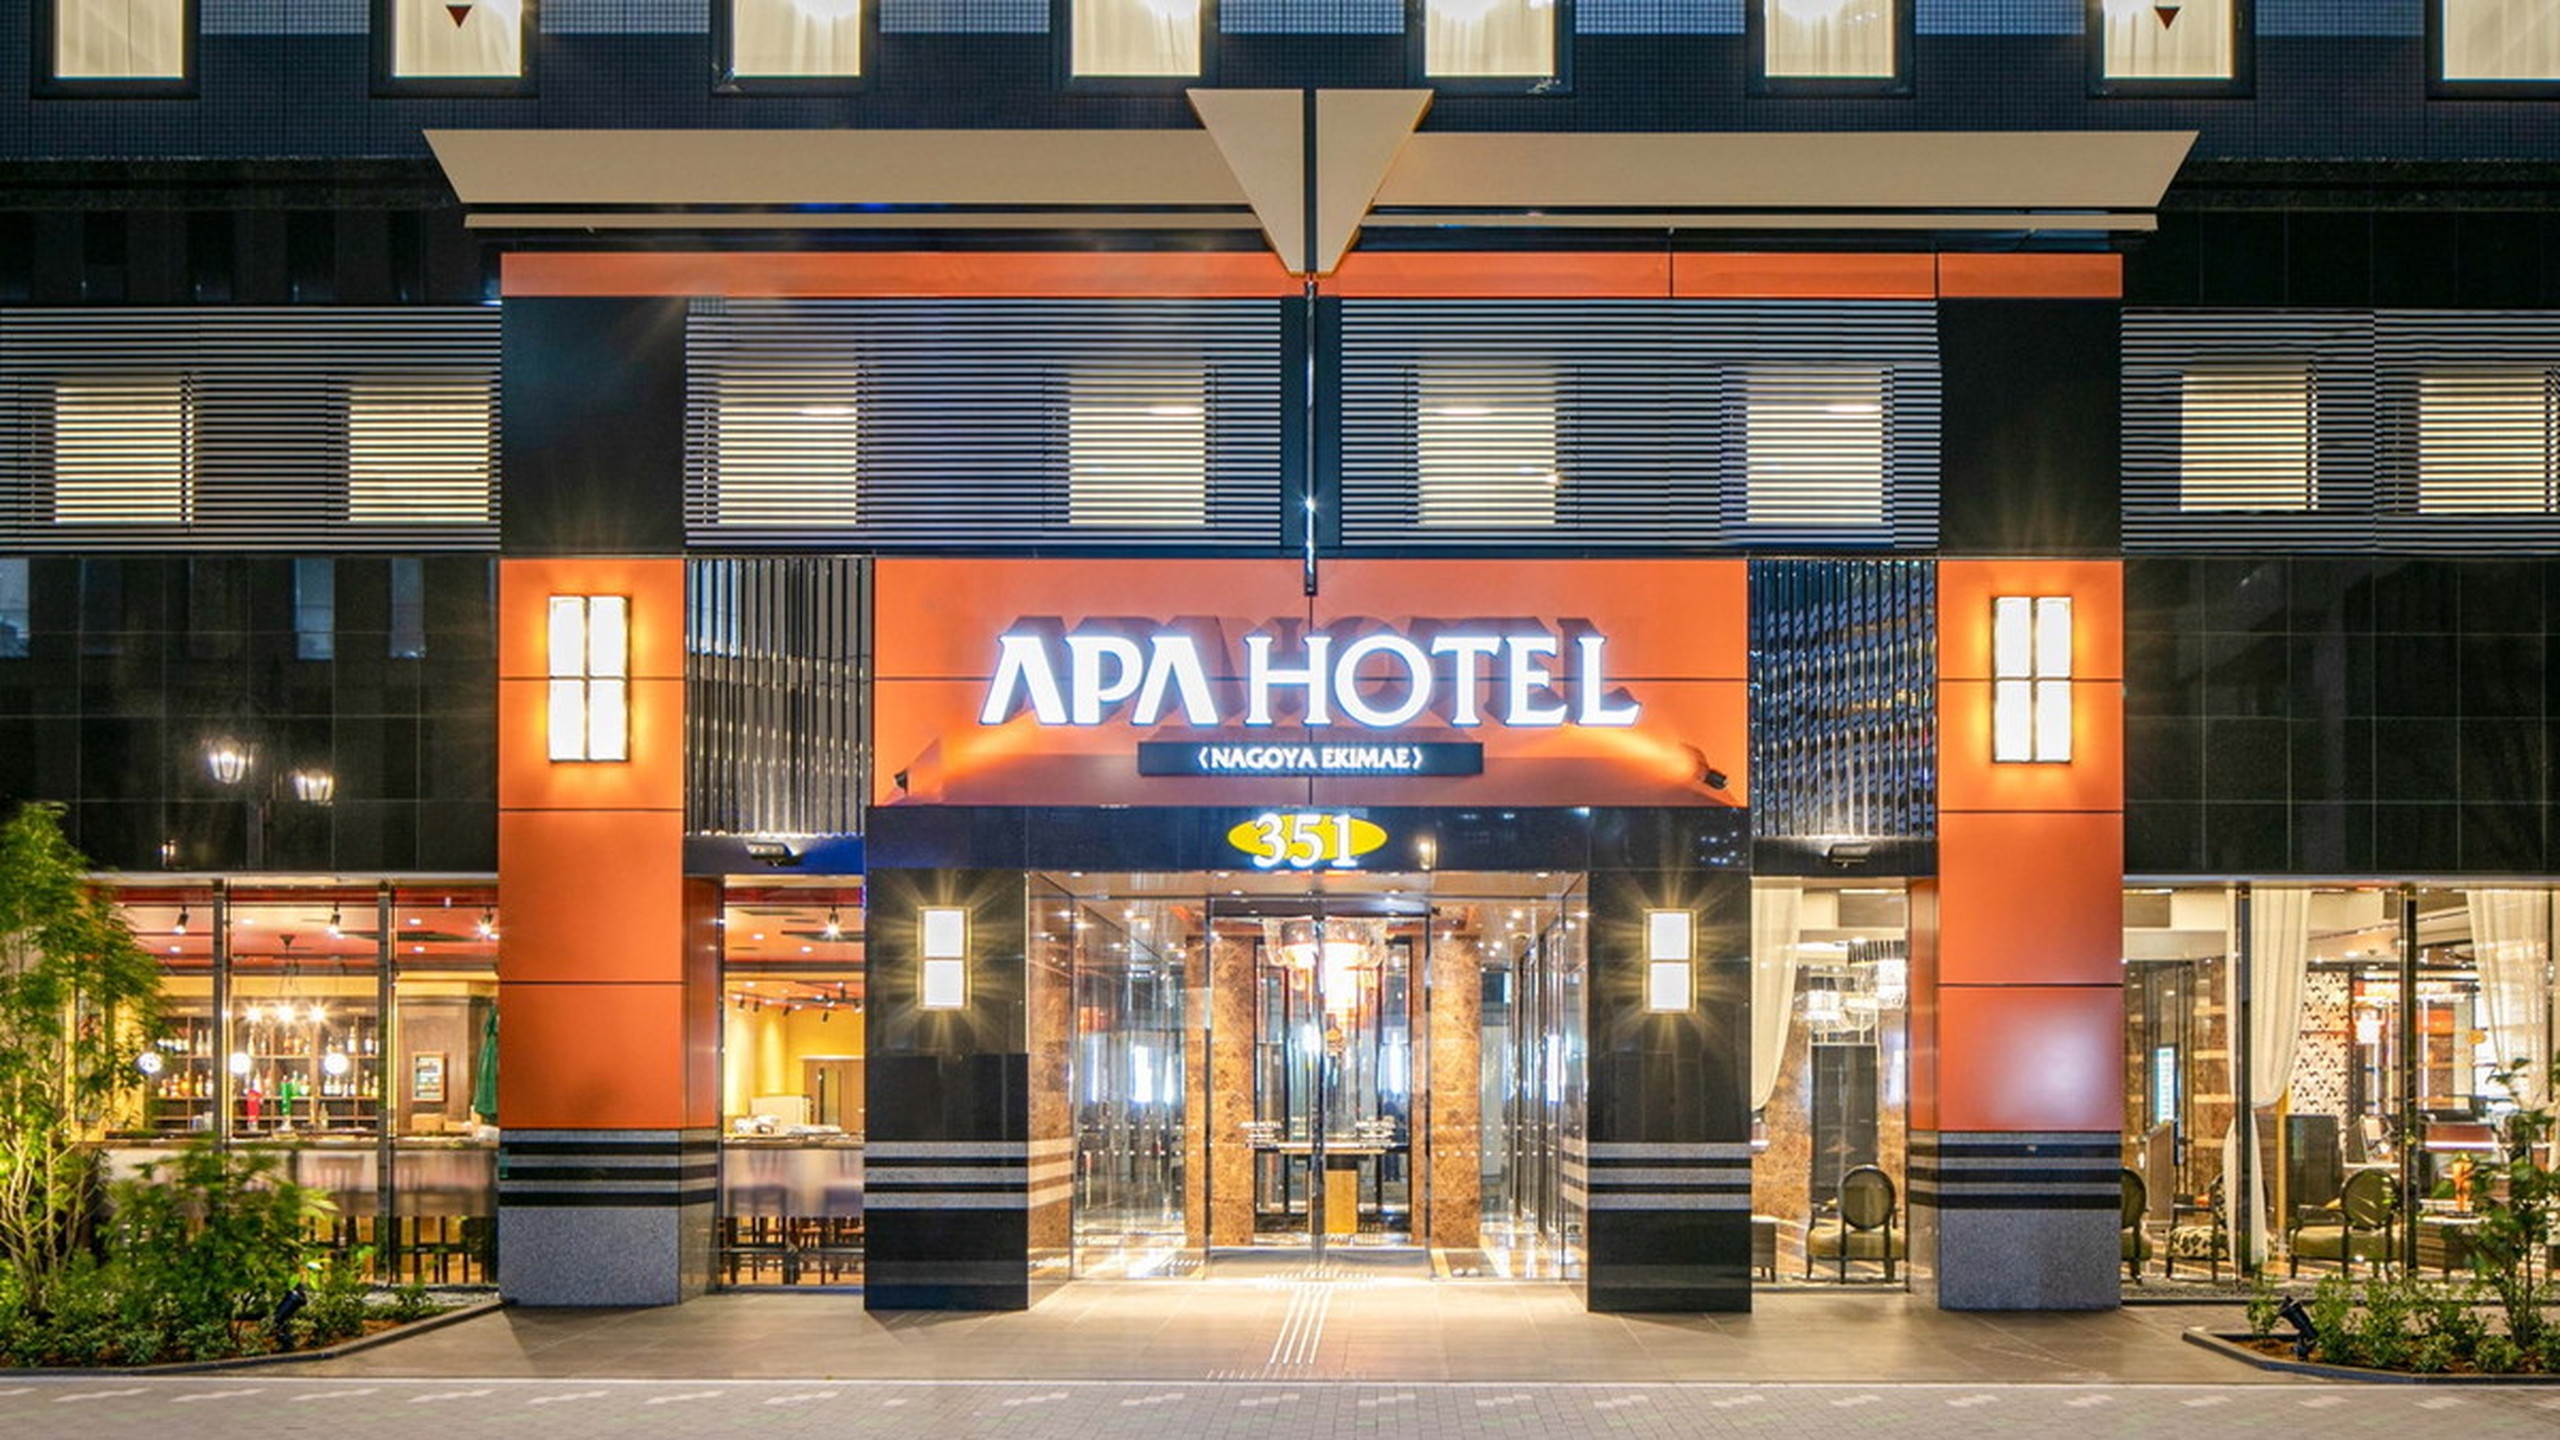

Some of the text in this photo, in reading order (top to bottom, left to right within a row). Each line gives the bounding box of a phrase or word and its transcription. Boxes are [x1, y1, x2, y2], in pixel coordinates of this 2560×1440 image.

[979, 634, 1641, 727] APA HOTEL
[1253, 813, 1358, 868] 351
